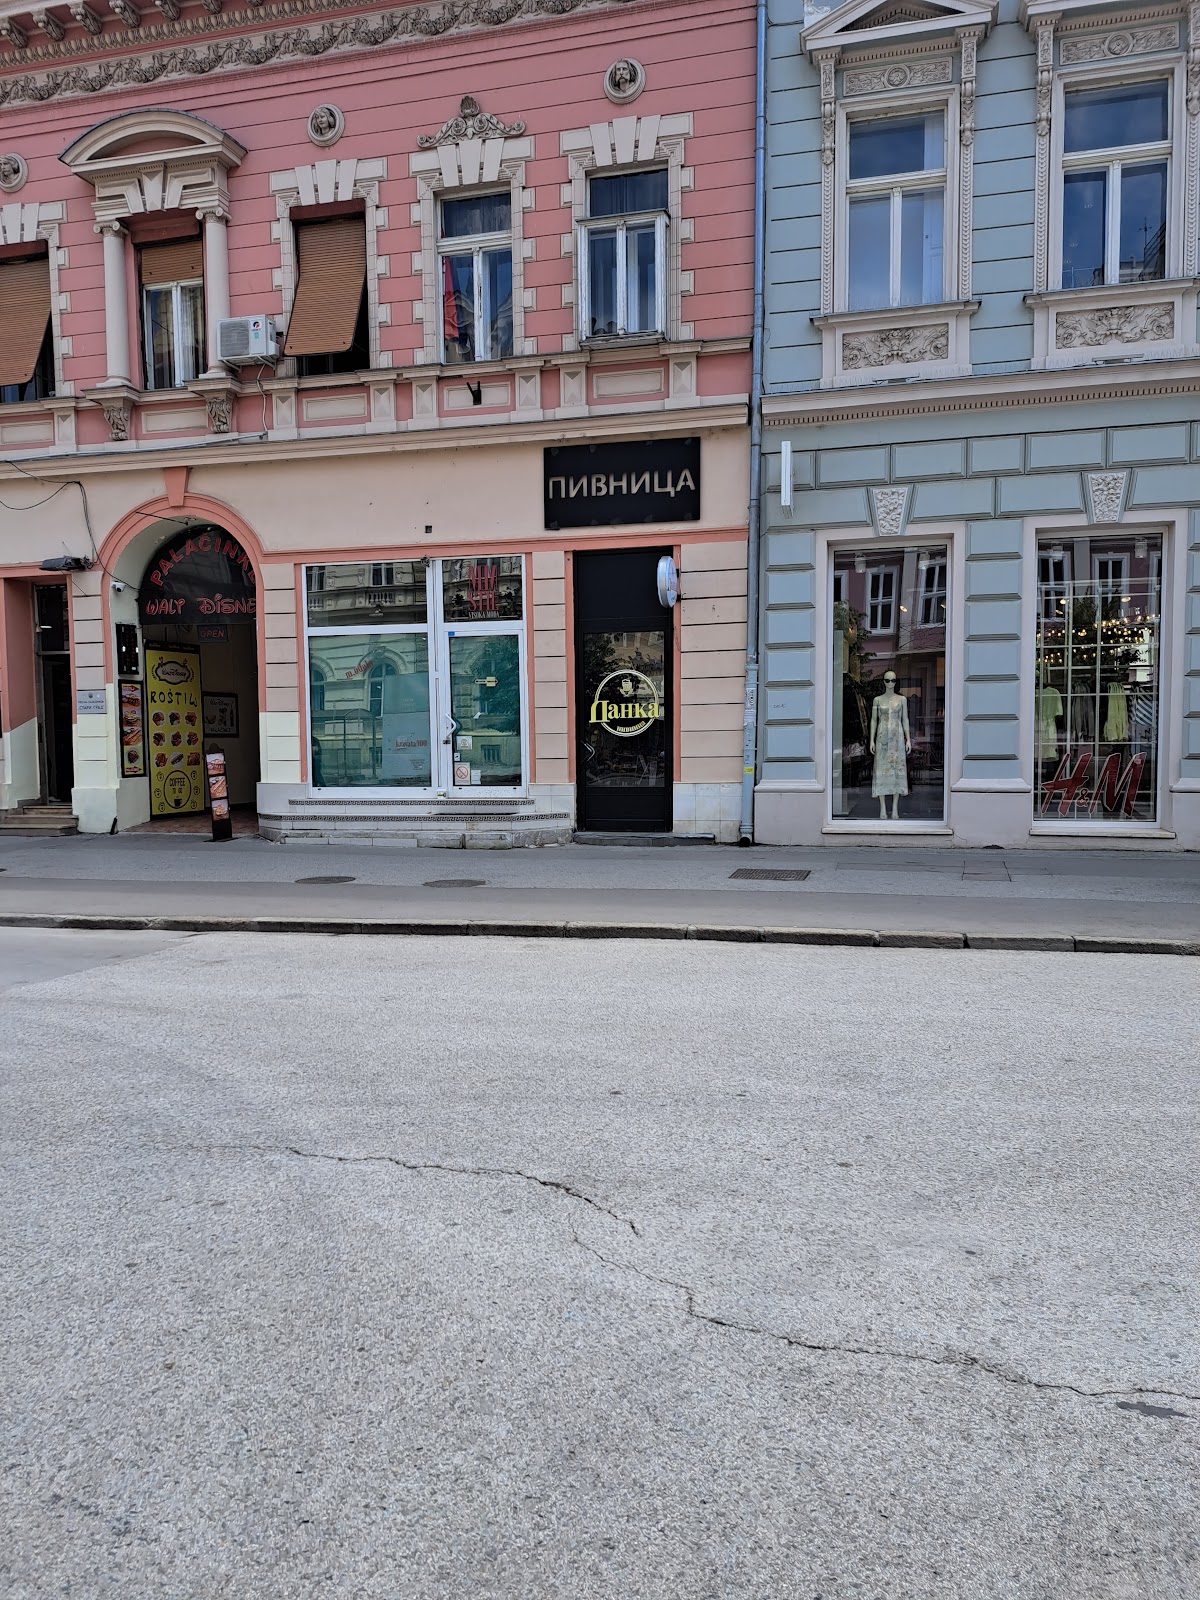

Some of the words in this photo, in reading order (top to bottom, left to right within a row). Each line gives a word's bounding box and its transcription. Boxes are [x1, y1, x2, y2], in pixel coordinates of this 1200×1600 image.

[549, 468, 696, 499] ПИВНИЦА
[200, 629, 225, 638] OPEN
[589, 700, 660, 723] Данка
[169, 777, 186, 787] COFFEE
[1041, 752, 1147, 817] H&M
